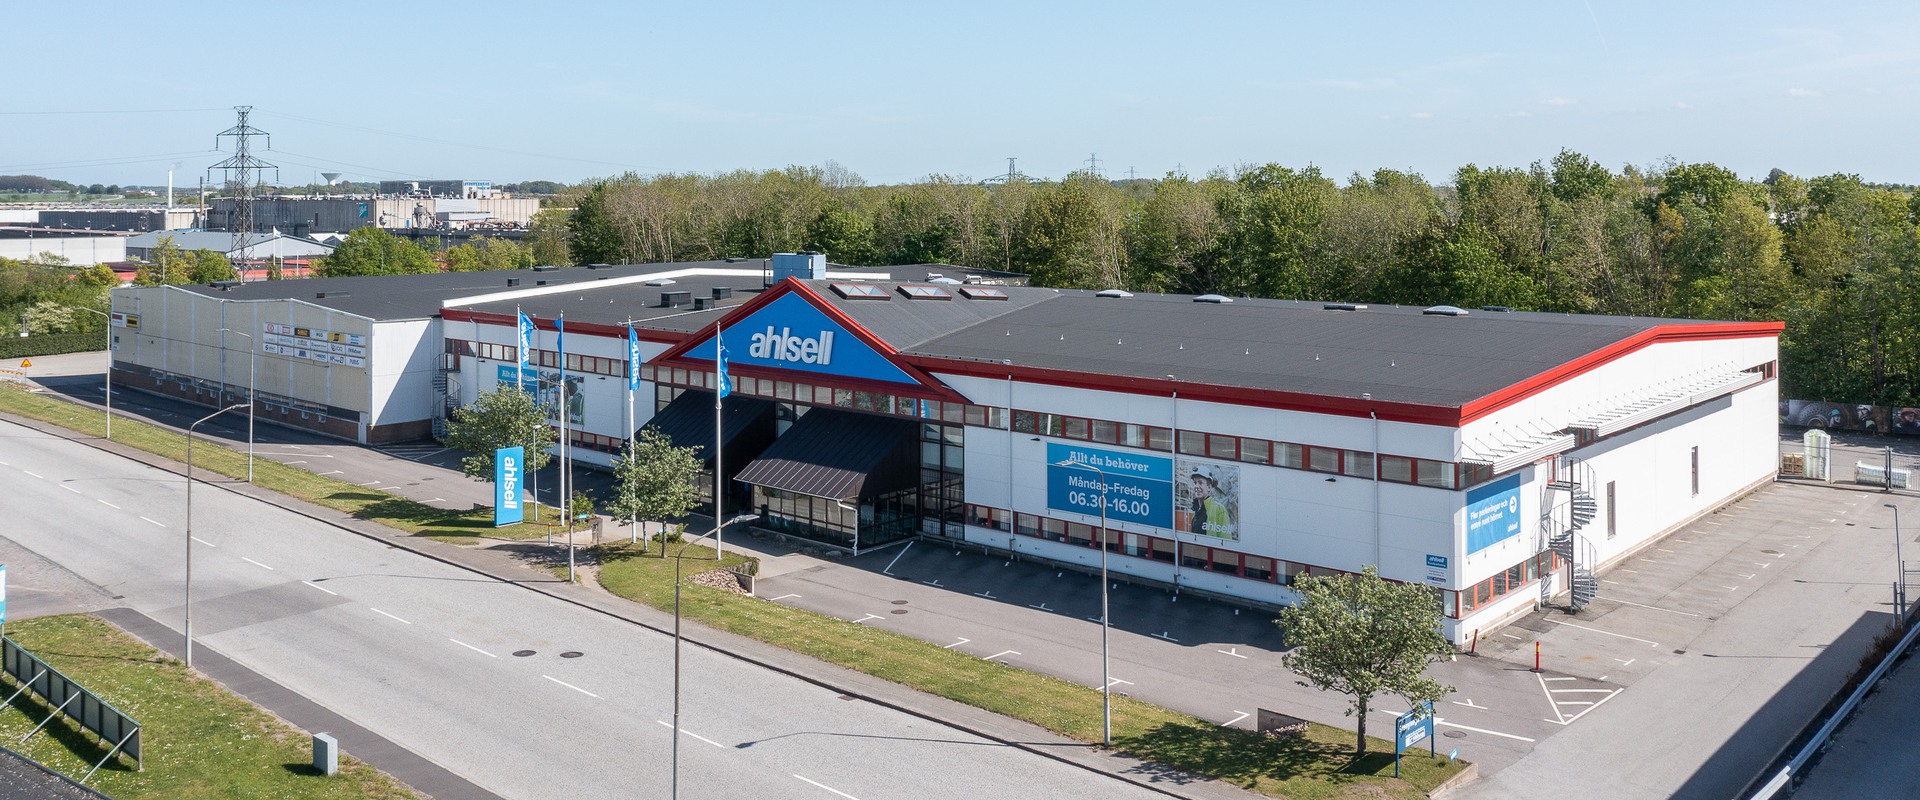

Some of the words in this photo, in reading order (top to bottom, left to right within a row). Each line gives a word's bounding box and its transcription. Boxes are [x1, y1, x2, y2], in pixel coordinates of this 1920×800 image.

[749, 325, 834, 365] ahlsell
[1069, 451, 1088, 463] Allt
[1090, 454, 1103, 466] du
[1105, 456, 1149, 472] behöver
[503, 456, 518, 509] ahlsell
[1201, 521, 1234, 534] ahlsell
